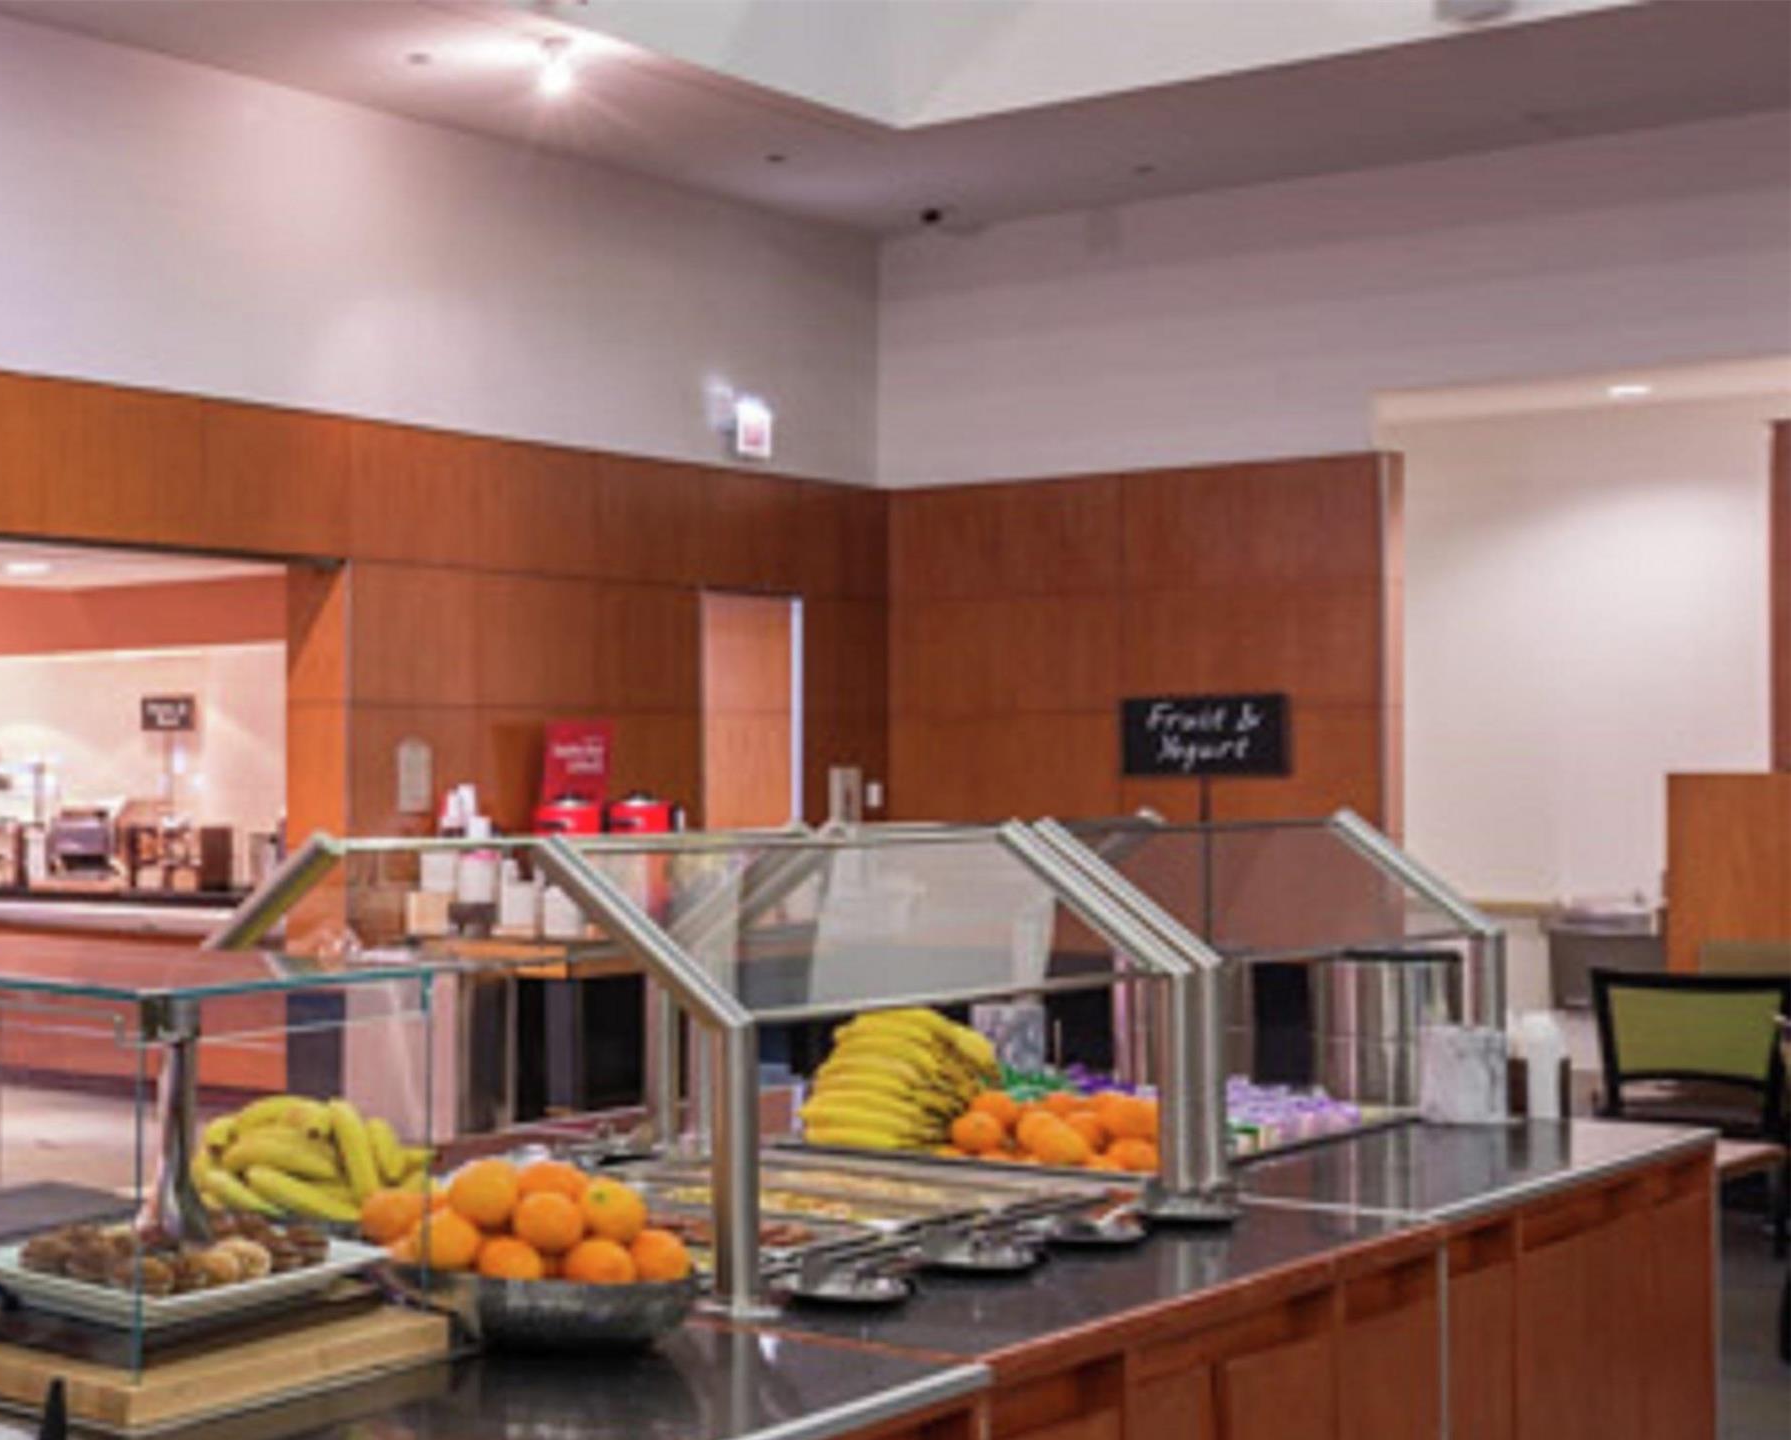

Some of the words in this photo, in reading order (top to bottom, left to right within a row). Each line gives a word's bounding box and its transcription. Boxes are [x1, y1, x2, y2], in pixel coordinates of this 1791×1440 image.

[1145, 701, 1227, 732] Fruit
[1235, 701, 1265, 732] &
[1155, 734, 1250, 774] Yogurt
